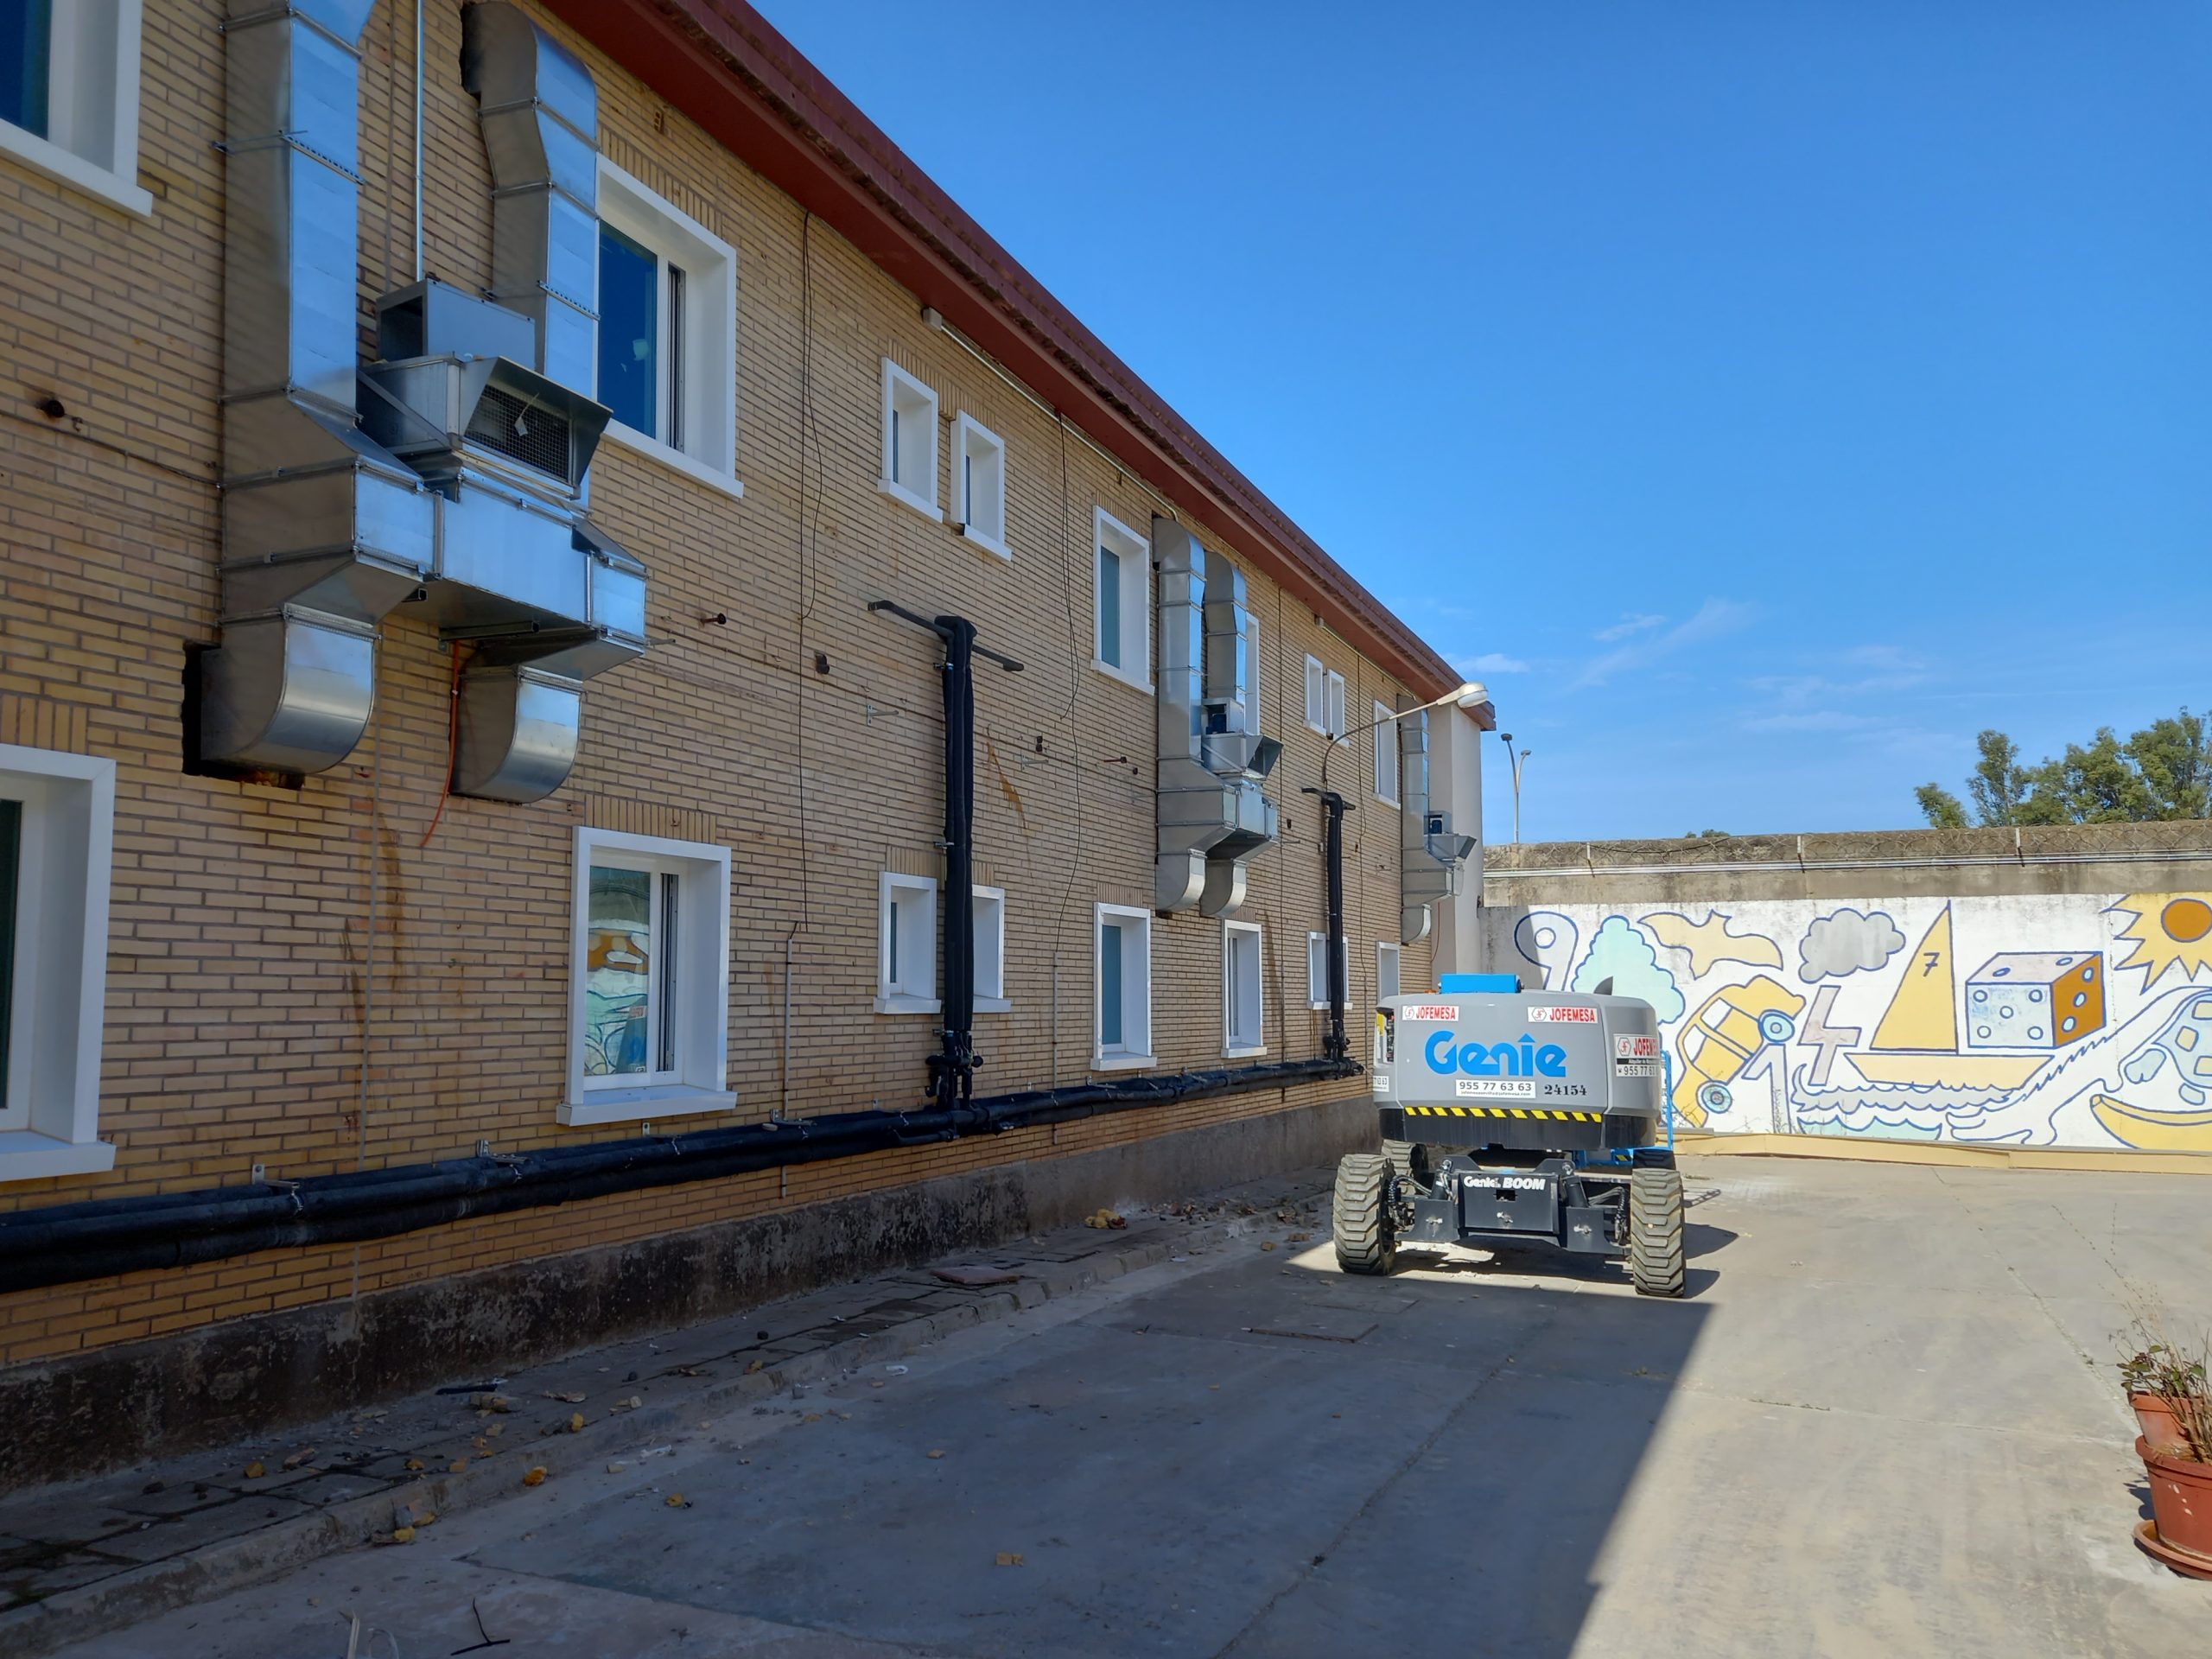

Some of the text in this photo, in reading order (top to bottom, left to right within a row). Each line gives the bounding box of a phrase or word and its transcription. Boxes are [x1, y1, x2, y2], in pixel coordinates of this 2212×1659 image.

[1922, 951, 1940, 977] 7
[1415, 1006, 1456, 1020] JOFEMESA
[1549, 1007, 1595, 1022] JOFEMESA
[1424, 1029, 1567, 1078] Genie
[1624, 1065, 1638, 1076] 955
[1640, 1065, 1648, 1076] 77
[1459, 1081, 1532, 1091] 955 77 63 63
[1543, 1084, 1587, 1096] 24154
[1502, 1176, 1546, 1191] BOOM
